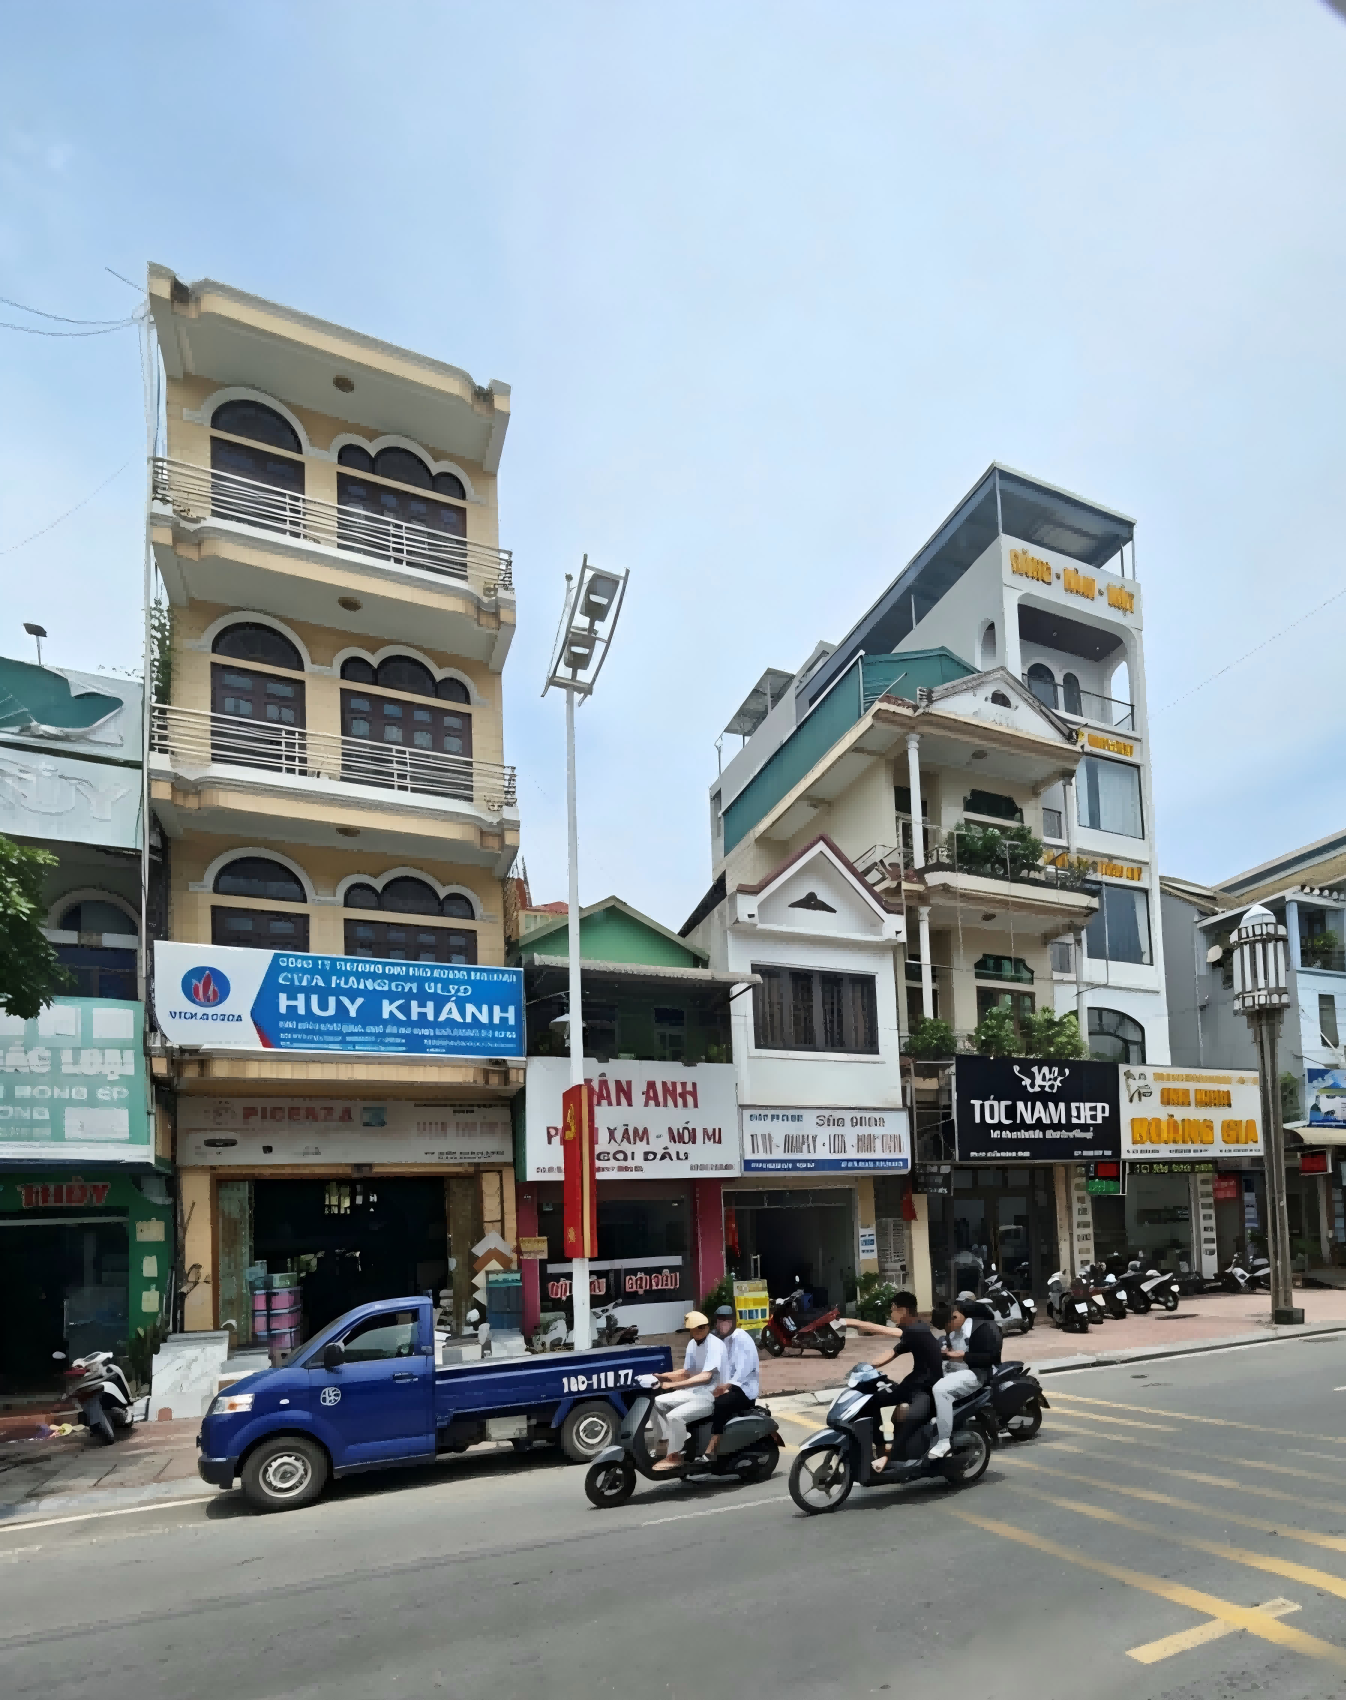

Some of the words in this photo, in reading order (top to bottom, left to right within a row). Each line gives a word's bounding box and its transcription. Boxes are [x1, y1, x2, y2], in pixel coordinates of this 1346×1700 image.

[278, 992, 364, 1018] HUY
[382, 996, 516, 1026] KHÁNH
[643, 1079, 699, 1109] ANH
[970, 1094, 1013, 1125] TÓC
[1016, 1100, 1066, 1125] NAM
